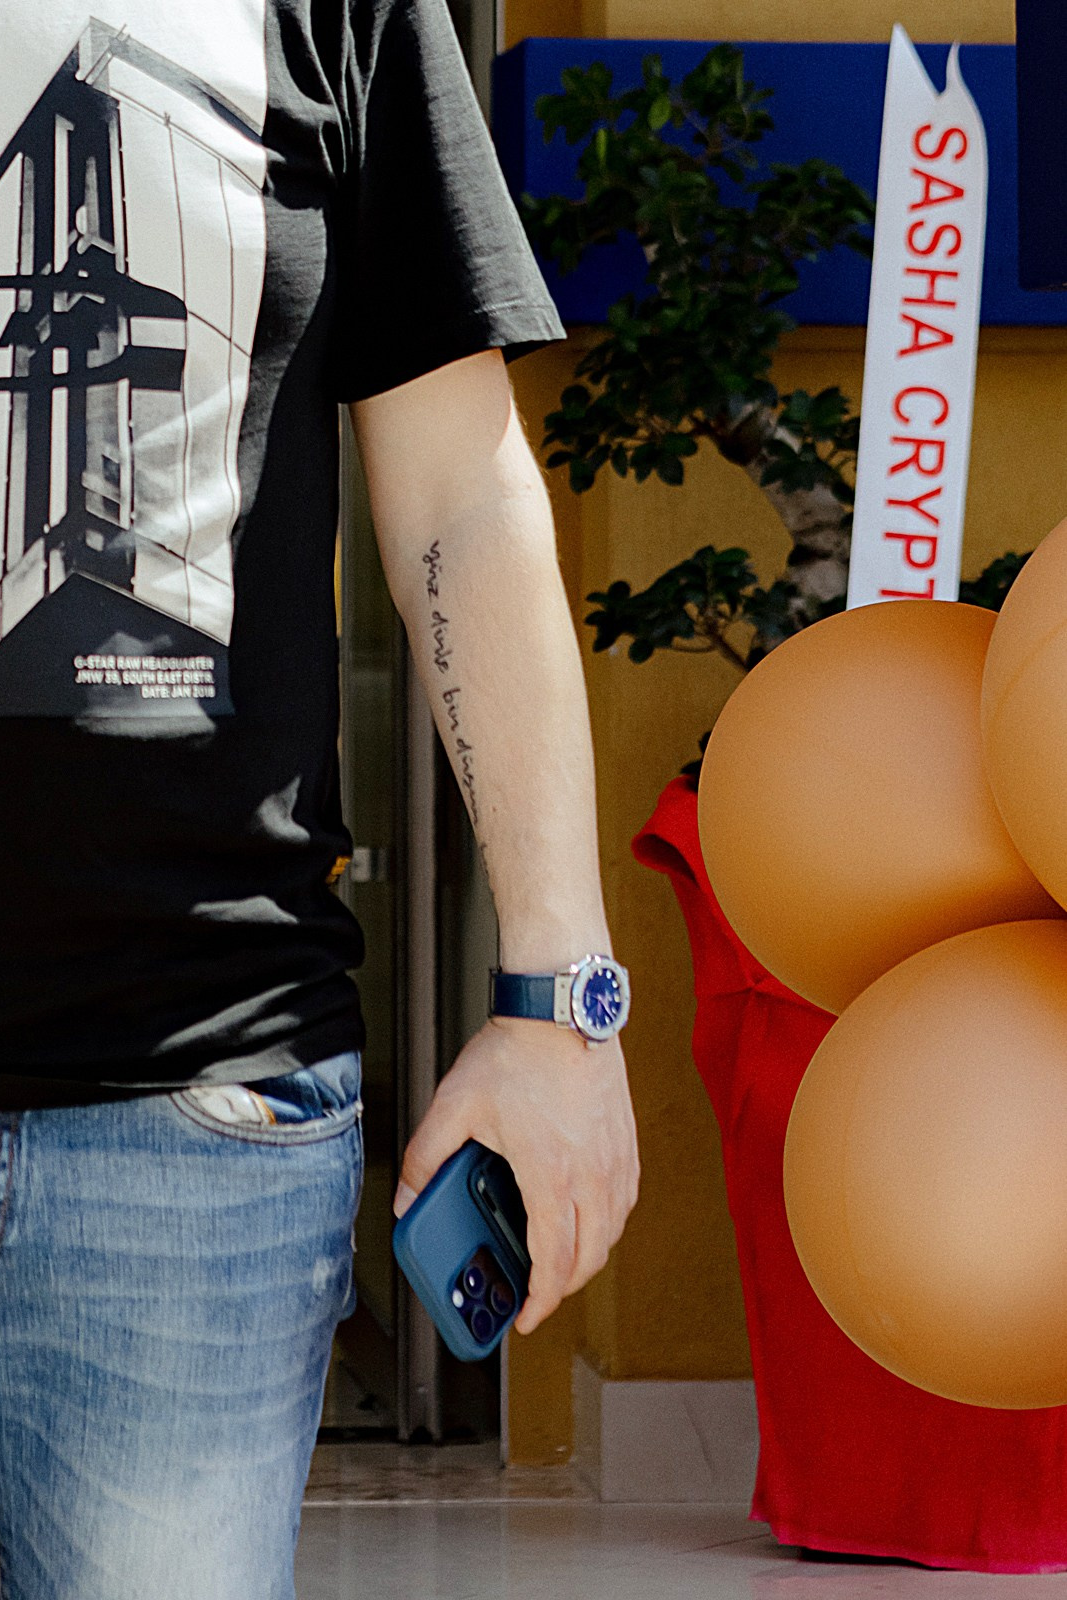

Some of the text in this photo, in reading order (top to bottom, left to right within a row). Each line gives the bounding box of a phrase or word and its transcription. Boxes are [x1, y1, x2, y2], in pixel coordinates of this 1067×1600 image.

[895, 122, 969, 359] SASHA
[74, 655, 116, 670] G-STAR
[117, 656, 142, 670] RAW
[123, 671, 156, 684] SOUTH
[157, 671, 183, 684] EAST
[141, 685, 170, 698] DATE:
[171, 685, 192, 698] JAN
